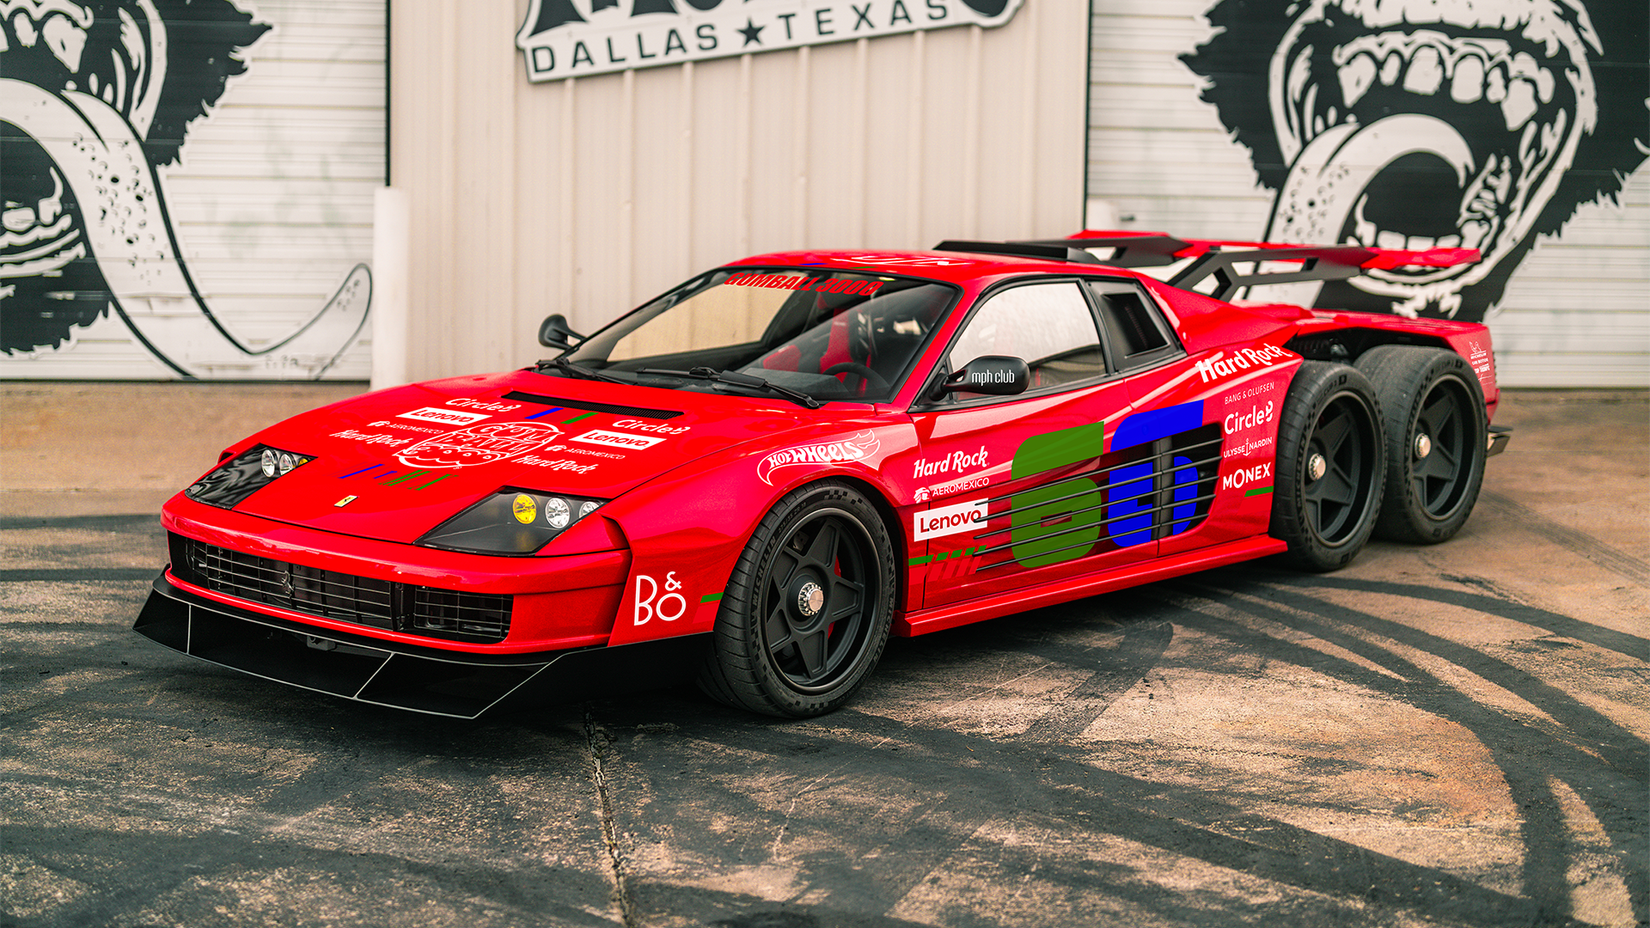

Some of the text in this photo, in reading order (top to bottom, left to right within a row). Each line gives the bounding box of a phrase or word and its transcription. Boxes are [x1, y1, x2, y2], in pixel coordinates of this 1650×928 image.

[531, 23, 719, 73] DALLAS
[777, 0, 948, 41] TEXAS
[723, 272, 884, 296] GUMBALL 3000
[1195, 343, 1293, 383] Hard Rock
[971, 369, 1015, 386] mph club
[1224, 392, 1242, 405] BANG
[1247, 381, 1275, 398] OLUFSEN
[410, 408, 475, 423] Lenovo
[328, 429, 414, 448] Hard Rock
[583, 430, 651, 447] Lenovo
[1223, 437, 1273, 458] ULYSSE NARDIN
[511, 455, 599, 475] Hard Rock
[913, 445, 989, 479] Hard Rock
[932, 477, 990, 497] AEROMEXICO
[1222, 462, 1272, 490] MONEX
[919, 509, 982, 534] Lenovo
